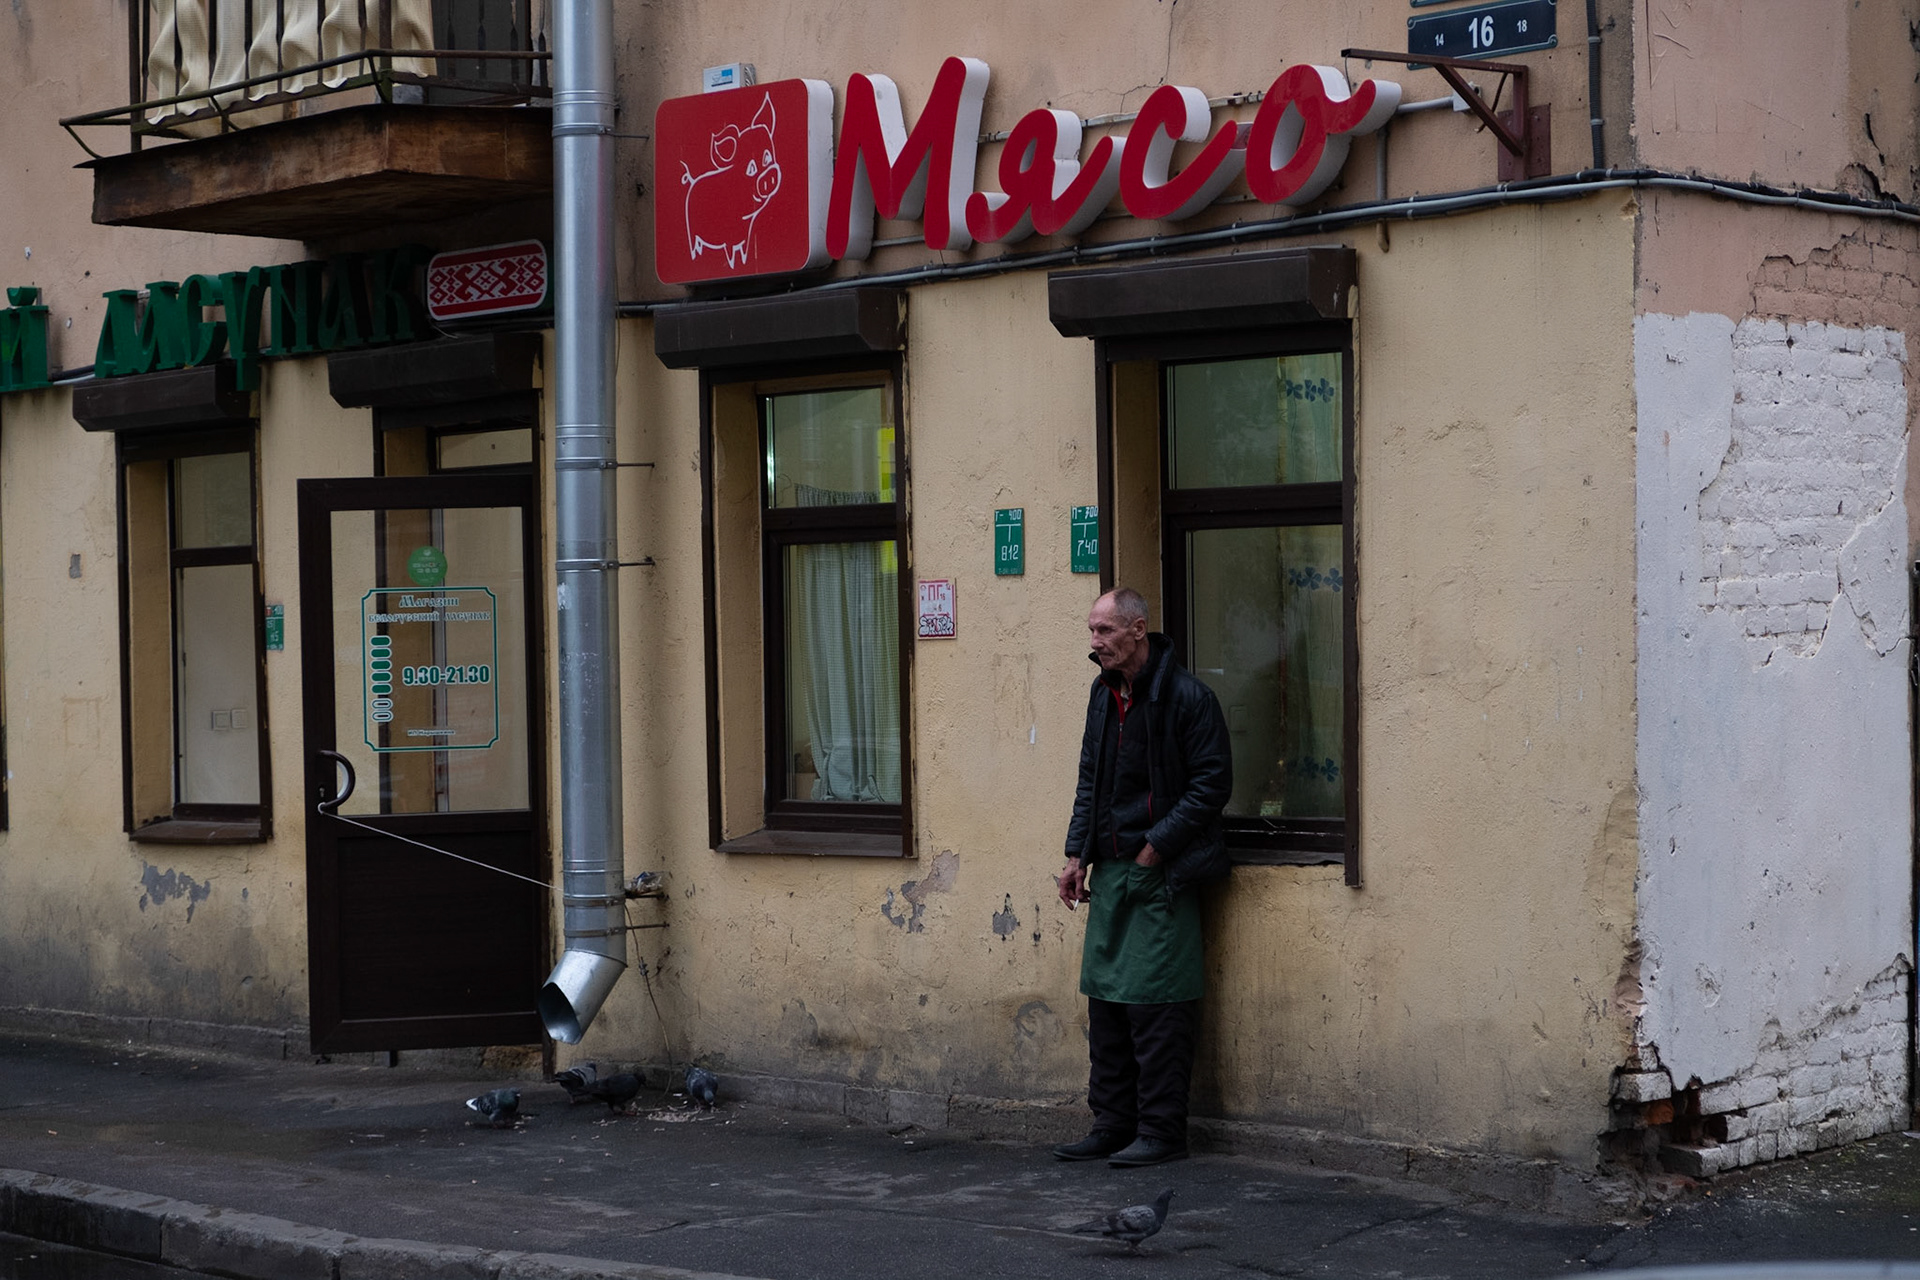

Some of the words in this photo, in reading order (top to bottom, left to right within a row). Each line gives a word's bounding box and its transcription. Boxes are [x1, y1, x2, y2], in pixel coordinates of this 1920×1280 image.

[1434, 33, 1445, 47] 14
[1468, 15, 1495, 49] 16
[1516, 19, 1528, 33] 18
[827, 55, 1402, 262] Мясо
[402, 665, 491, 686] 9.30-21.30
